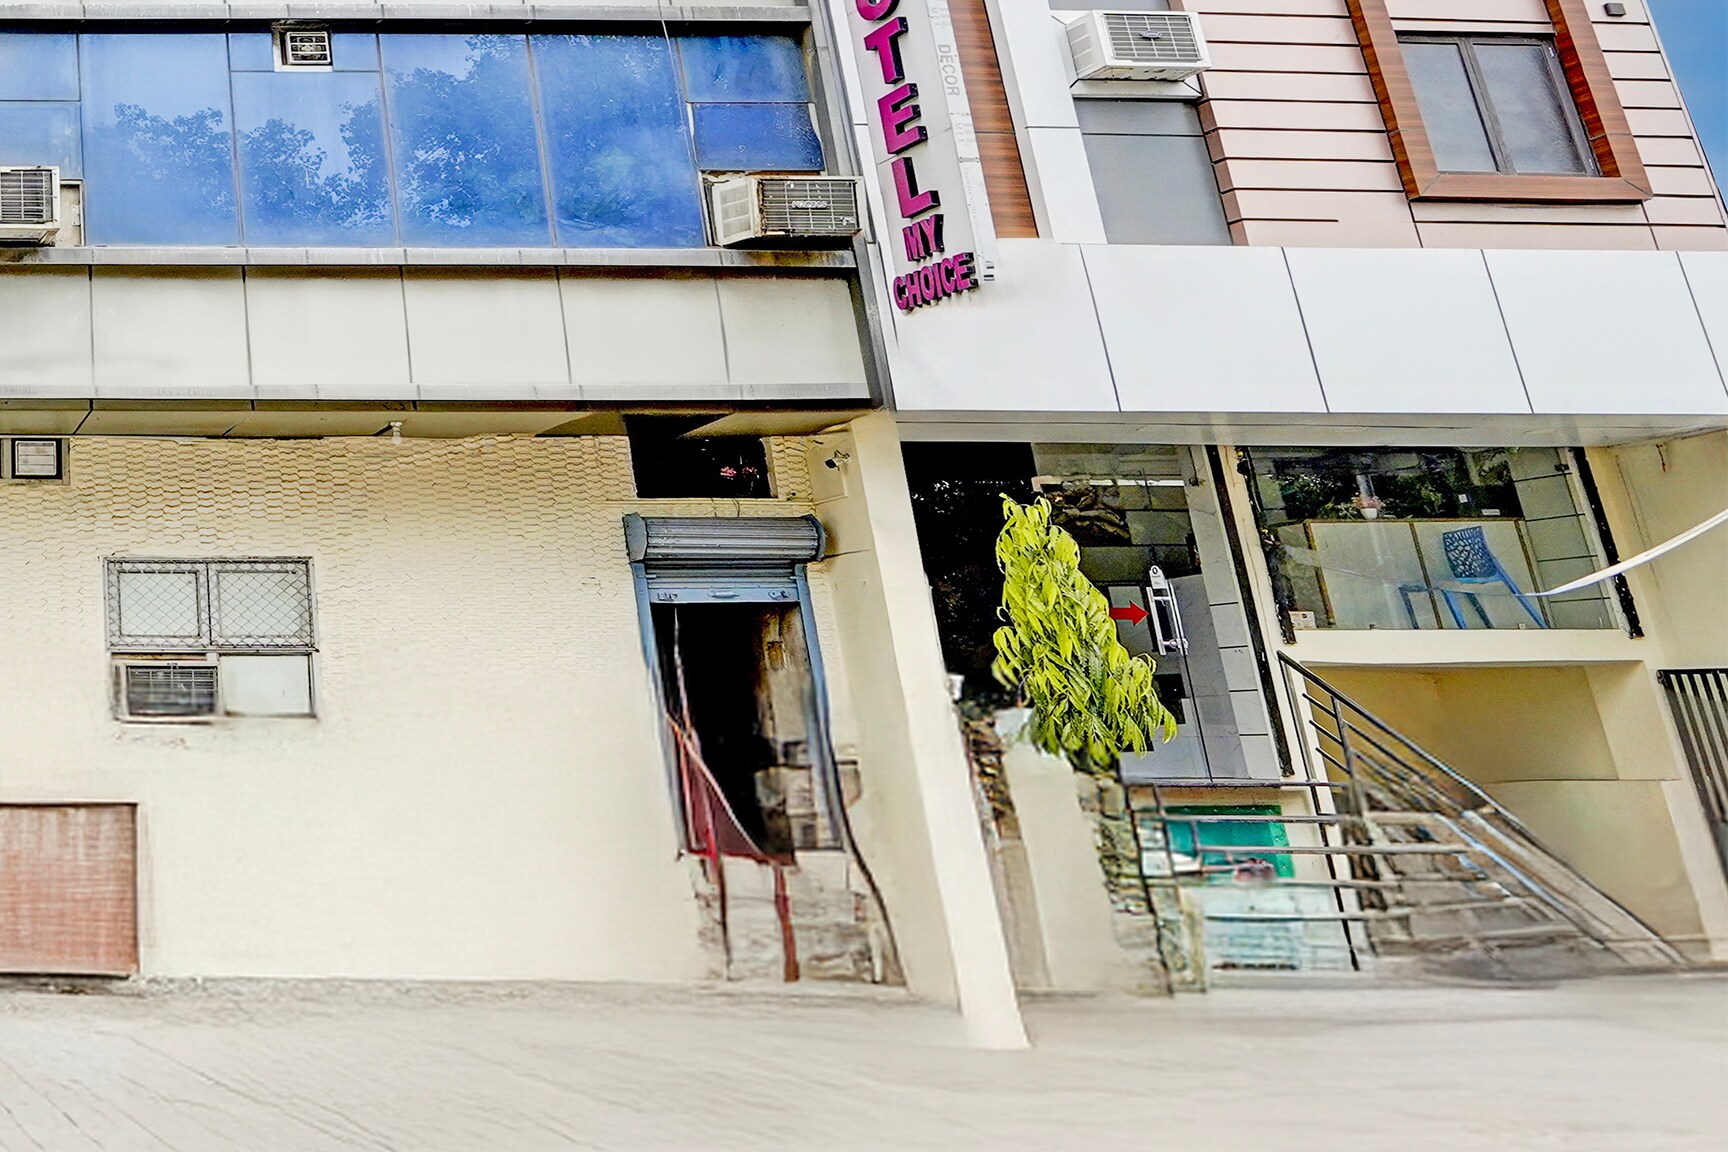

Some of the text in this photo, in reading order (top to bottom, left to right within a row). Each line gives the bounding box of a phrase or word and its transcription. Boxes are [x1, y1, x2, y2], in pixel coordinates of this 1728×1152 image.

[938, 43, 960, 97] DECOR
[902, 214, 944, 262] MY
[893, 252, 978, 311] CHOICE
